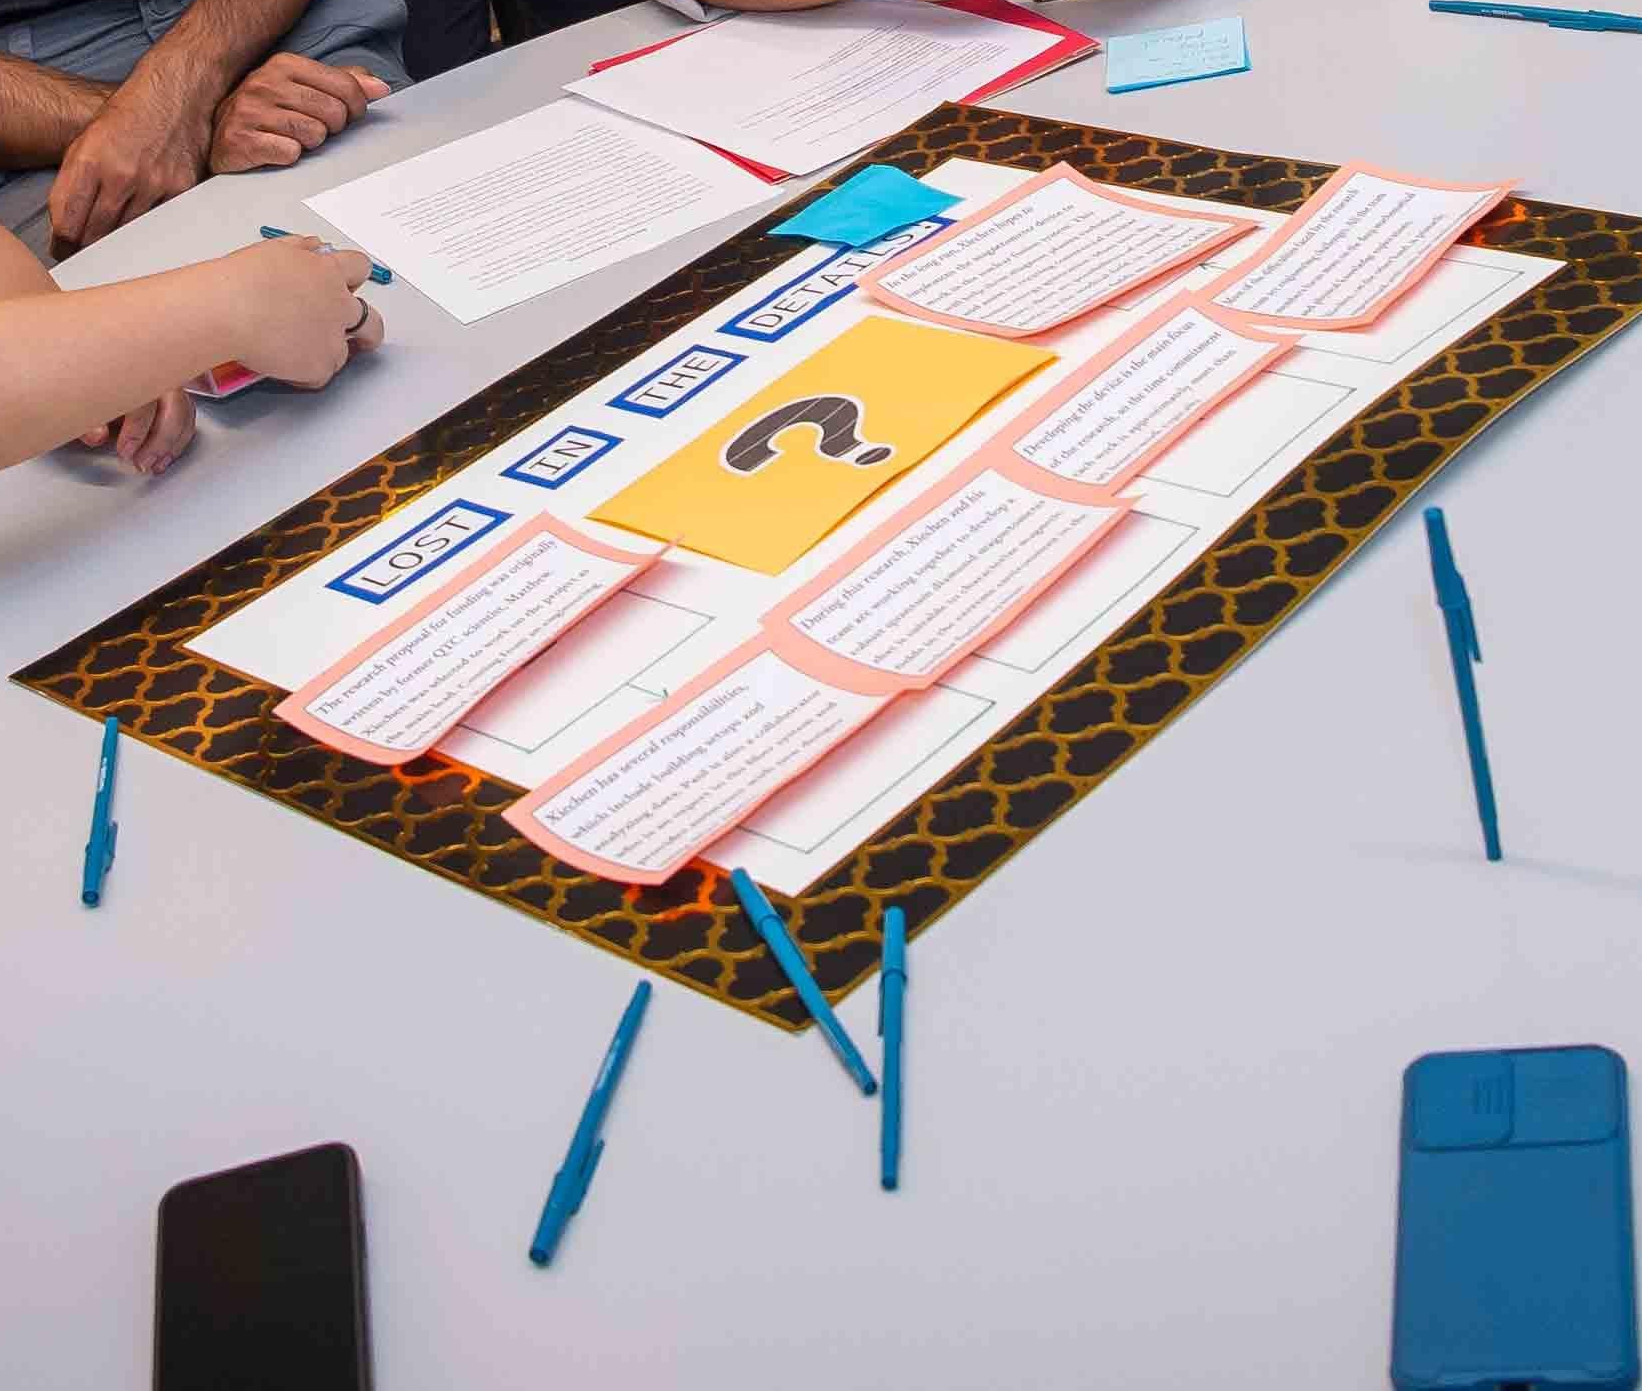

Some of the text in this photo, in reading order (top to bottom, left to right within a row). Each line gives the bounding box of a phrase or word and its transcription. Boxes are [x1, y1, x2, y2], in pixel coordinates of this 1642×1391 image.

[900, 267, 917, 281] the
[914, 256, 943, 277] long
[1022, 409, 1082, 458] Developing
[1077, 397, 1095, 415] the
[1093, 375, 1124, 401] device
[1130, 356, 1149, 373] the
[1146, 338, 1175, 360] main
[1169, 320, 1197, 343] focus
[1060, 446, 1079, 460] the
[1126, 392, 1147, 409] the
[1144, 375, 1169, 396] time
[1165, 330, 1223, 378] commitment
[361, 514, 472, 587] LOST
[535, 438, 593, 476] IN
[638, 356, 723, 409] THE
[799, 598, 846, 631] During
[842, 581, 865, 601] this
[949, 499, 970, 519] and
[965, 489, 987, 507] his
[871, 575, 917, 610] working
[968, 503, 1010, 533] develop
[314, 538, 559, 716] The research proposal for funding was originally
[340, 694, 385, 727] written
[378, 685, 400, 700] by
[395, 656, 436, 688] former
[431, 634, 460, 660] QTC
[406, 688, 430, 705] was
[428, 656, 471, 689] selected
[524, 603, 543, 618] the
[594, 770, 621, 790] has
[619, 740, 661, 774] several
[650, 745, 709, 783] building
